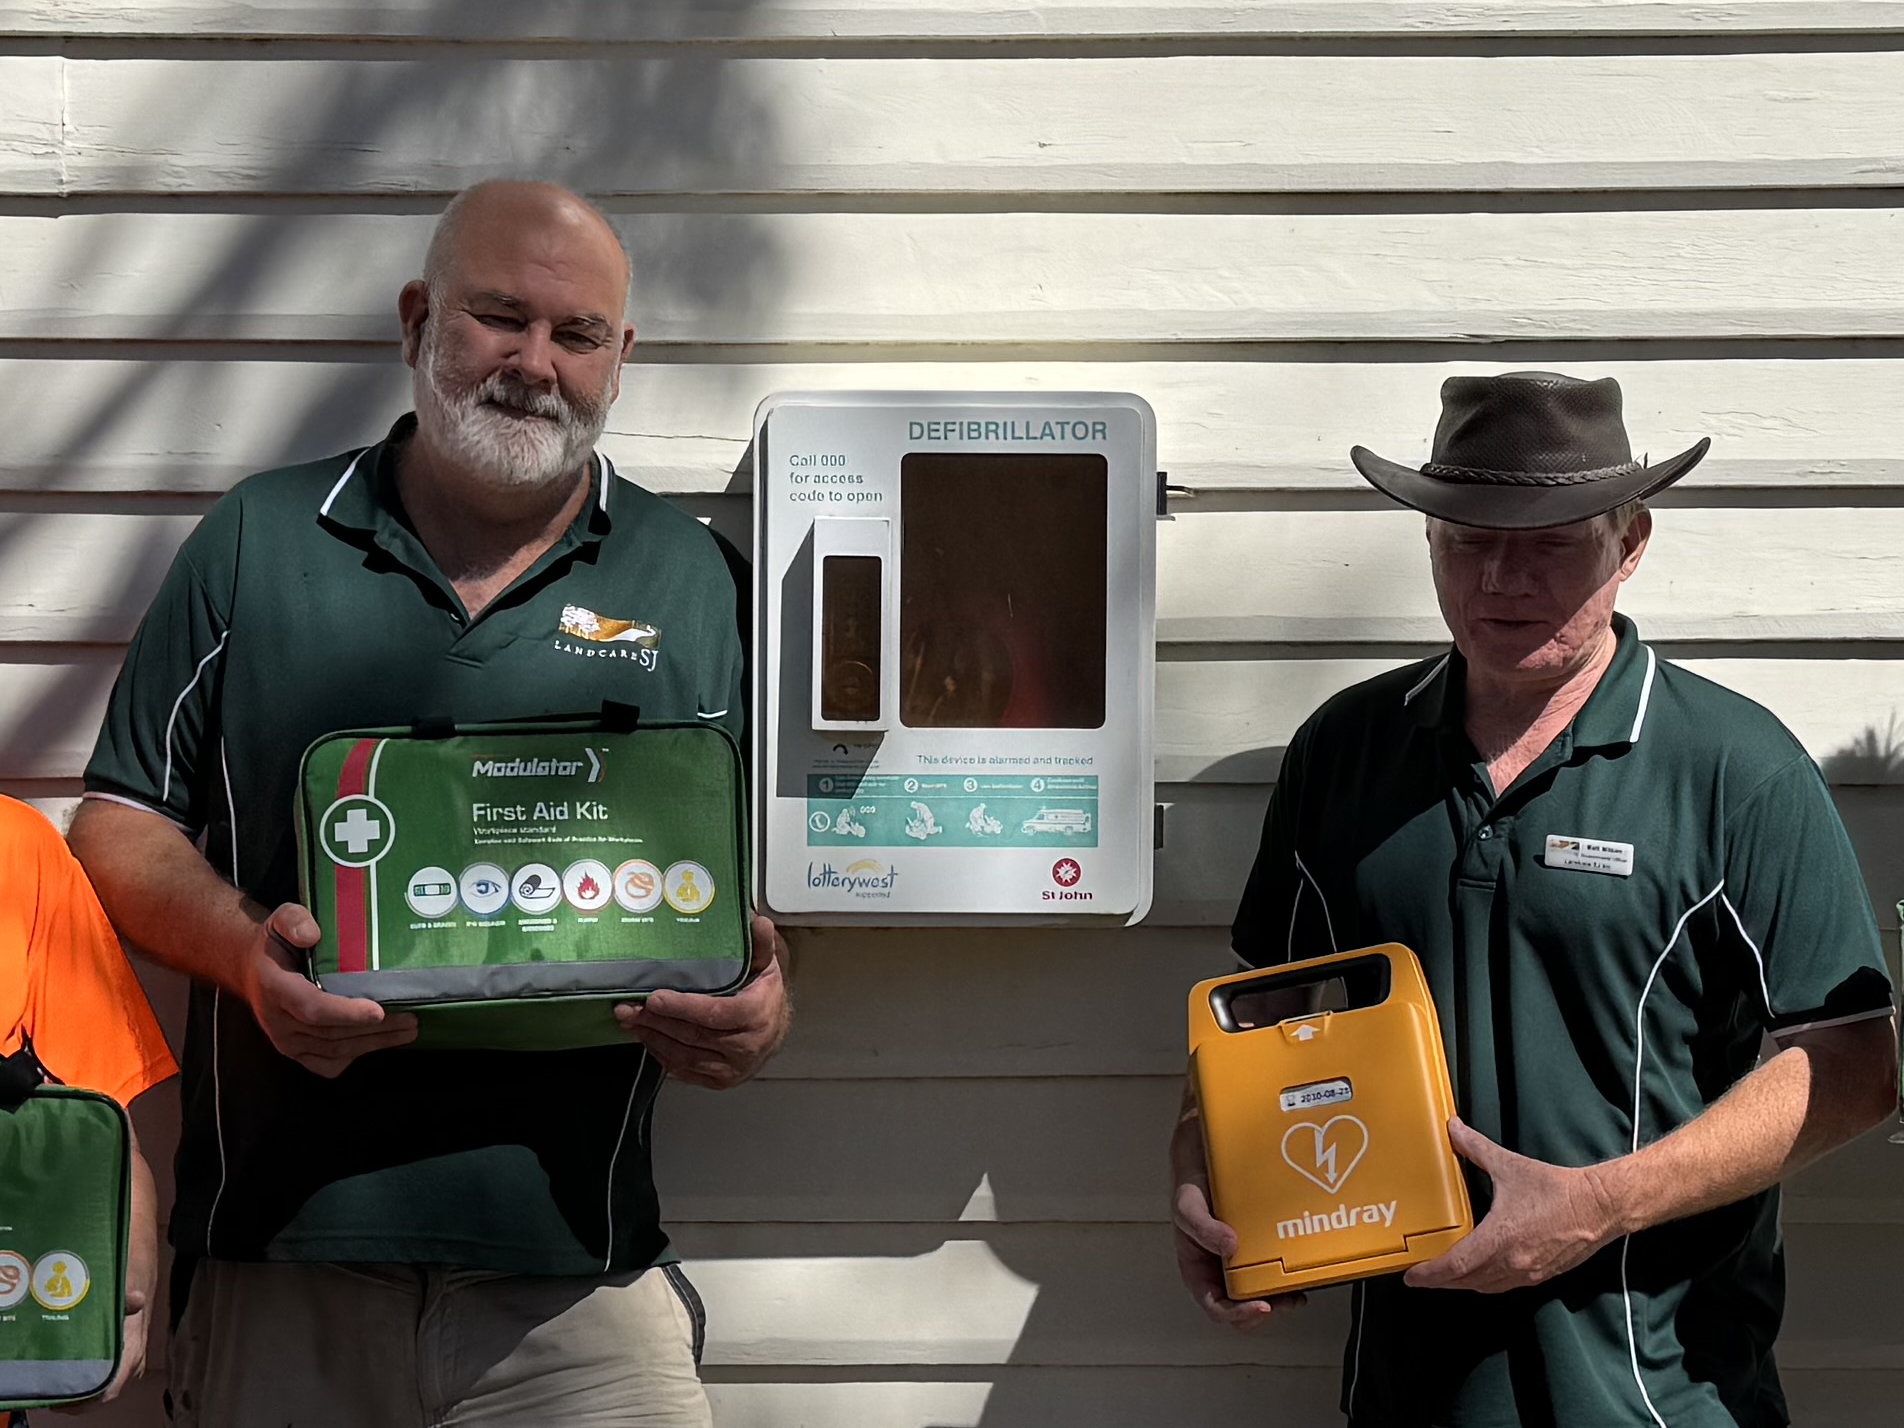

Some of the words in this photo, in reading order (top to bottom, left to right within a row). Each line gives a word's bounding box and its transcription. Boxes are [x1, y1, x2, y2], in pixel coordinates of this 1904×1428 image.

[908, 421, 1108, 441] DEFIBRILLATOR
[789, 454, 816, 466] Call
[820, 454, 846, 466] 000
[789, 472, 810, 484] for
[813, 474, 864, 484] access
[789, 490, 825, 502] code
[829, 491, 843, 502] to
[847, 492, 883, 504] open
[554, 640, 637, 661] LANDCARE
[639, 648, 658, 672] SJ
[472, 758, 584, 778] Modulator
[916, 754, 939, 764] This
[941, 755, 975, 765] device
[989, 756, 1030, 765] alarmed
[1033, 756, 1052, 765] and
[1054, 756, 1093, 765] tracked
[472, 803, 527, 822] First
[532, 801, 569, 821] Aid
[575, 801, 609, 820] Kit
[807, 861, 899, 893] lotterywest
[1041, 890, 1055, 900] St
[1058, 890, 1093, 901] John
[1276, 1200, 1397, 1240] mindray
